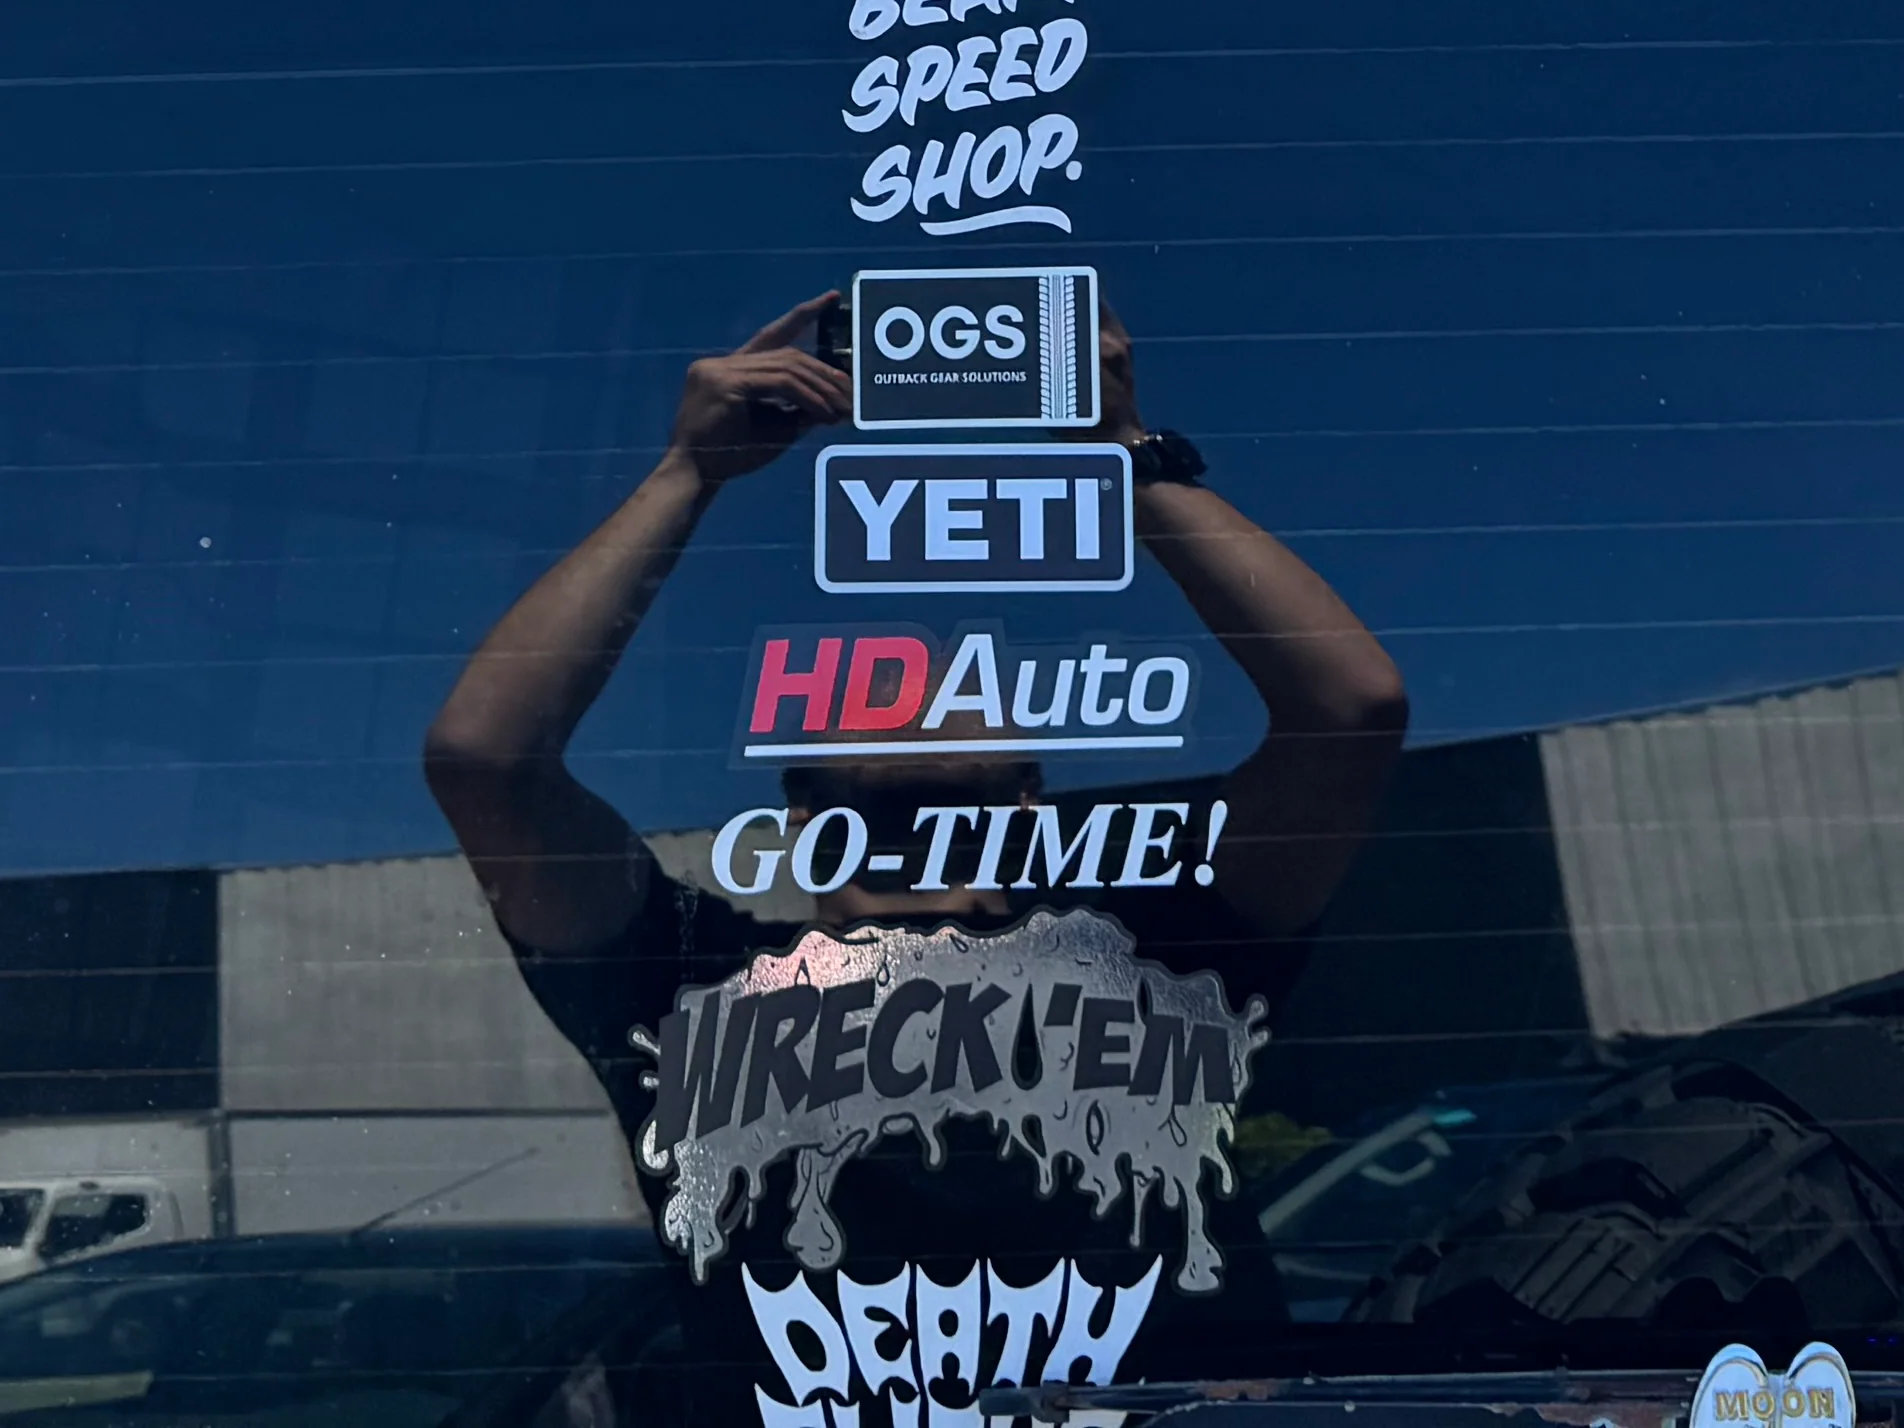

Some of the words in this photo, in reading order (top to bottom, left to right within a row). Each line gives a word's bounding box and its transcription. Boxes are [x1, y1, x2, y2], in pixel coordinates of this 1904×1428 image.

[842, 18, 1087, 133] SPEED
[850, 113, 1082, 223] SHOP.
[874, 305, 1026, 361] OGS
[874, 373, 928, 384] OUTBACK
[930, 372, 959, 383] GEAR
[962, 371, 1027, 383] SOLUTIONS
[838, 478, 1100, 561] YETI
[749, 633, 1189, 732] HDAuto
[711, 800, 1229, 894] GO-TIME!
[654, 978, 1012, 1153] WRECK
[741, 1253, 1163, 1408] DEATH
[1715, 1387, 1836, 1421] MOON
